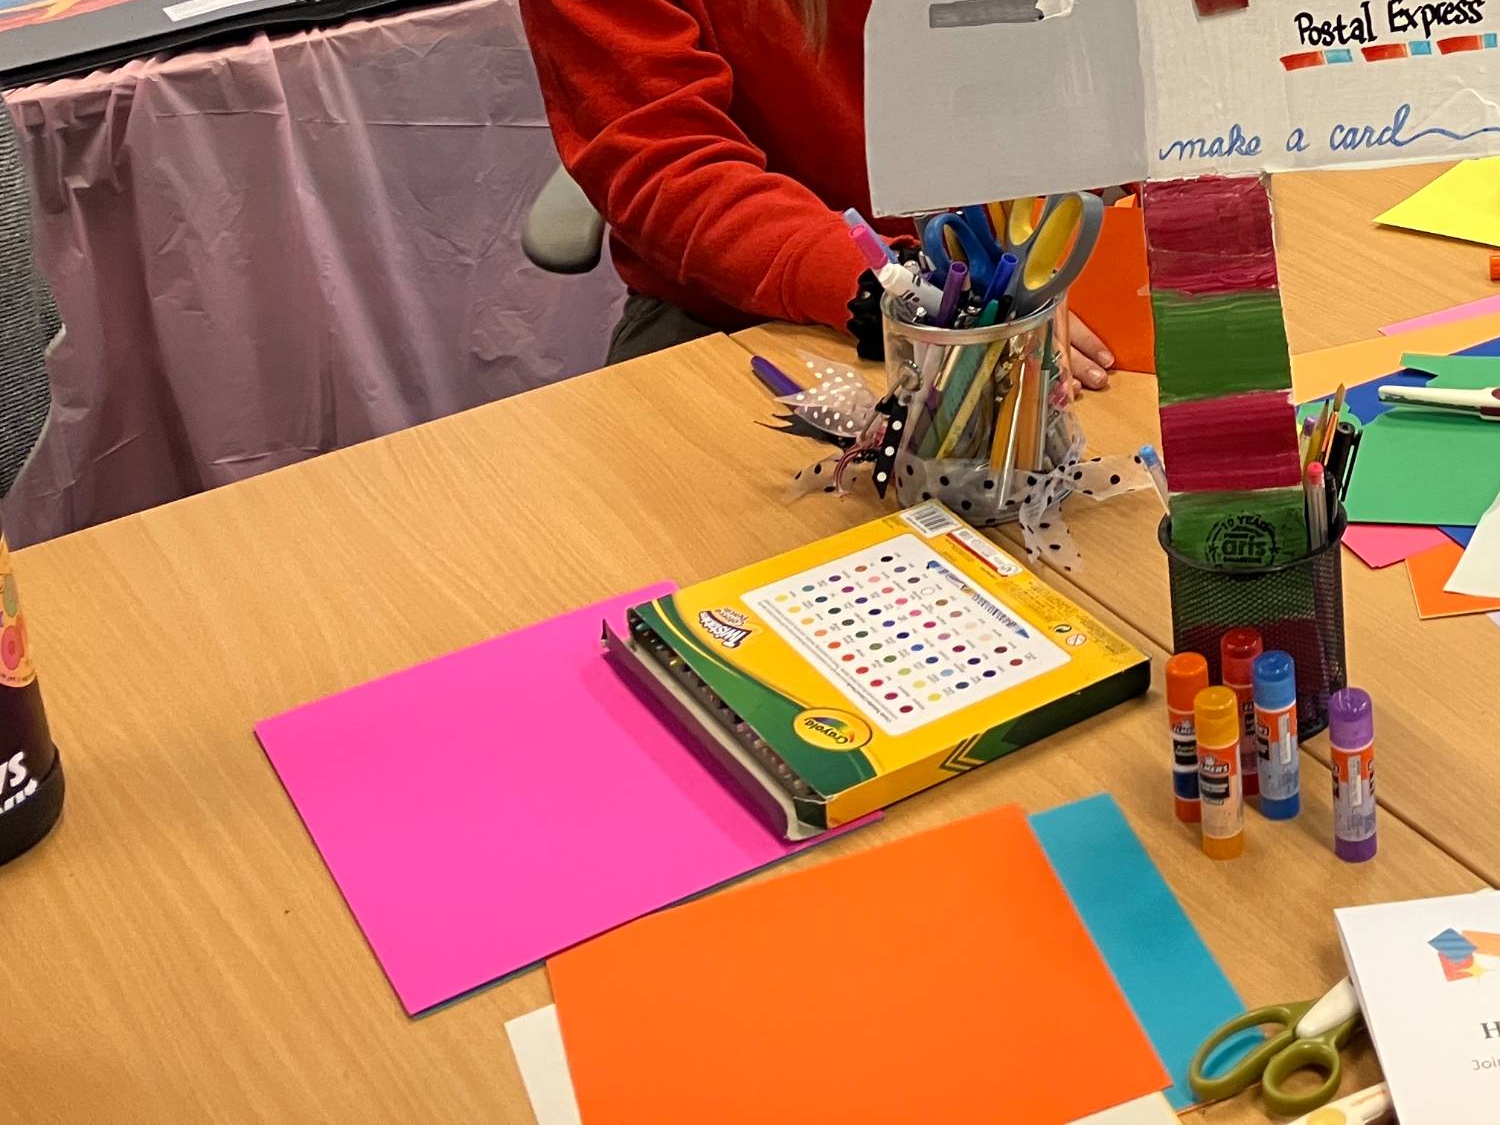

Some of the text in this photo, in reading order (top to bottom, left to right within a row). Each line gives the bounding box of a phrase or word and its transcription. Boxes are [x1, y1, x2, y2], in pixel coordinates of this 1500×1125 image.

[1294, 1, 1378, 45] Postal
[1159, 103, 1435, 161] make a card
[804, 714, 850, 745] Crayola
